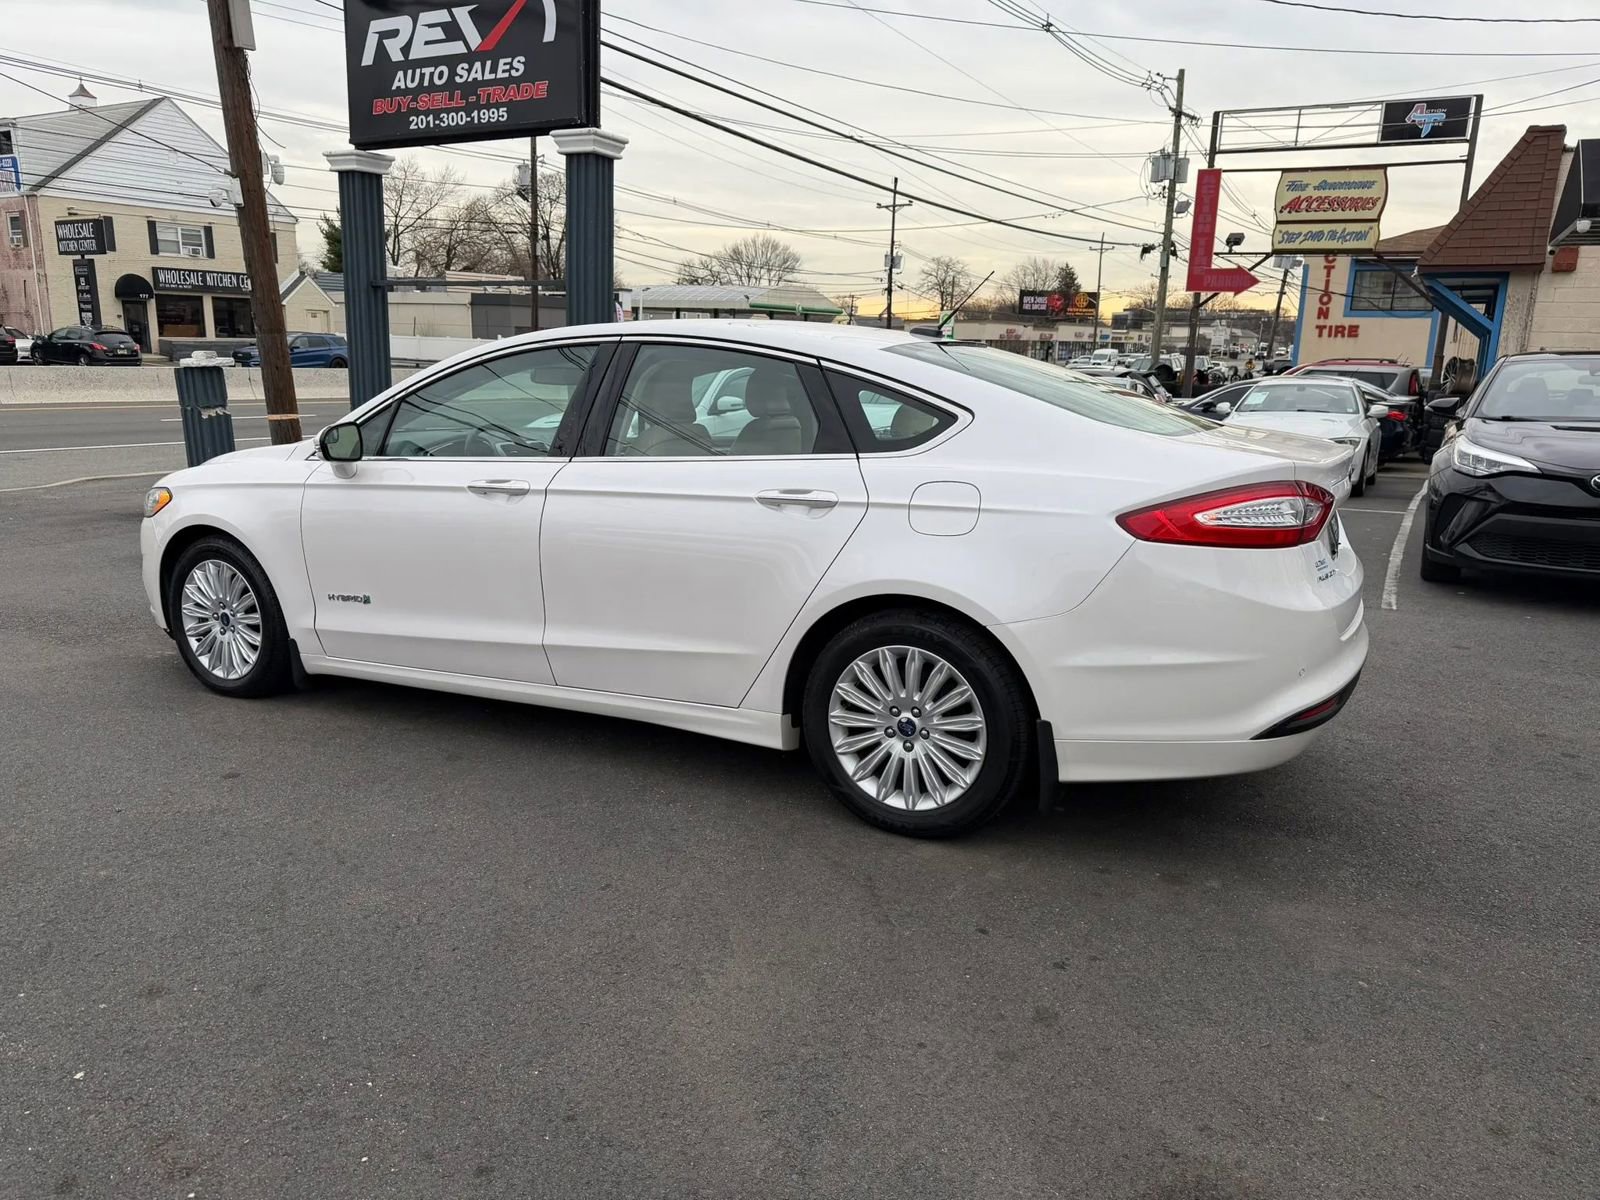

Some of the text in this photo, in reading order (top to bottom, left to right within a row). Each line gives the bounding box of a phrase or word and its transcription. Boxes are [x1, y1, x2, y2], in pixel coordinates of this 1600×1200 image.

[392, 56, 526, 90] AUTO SALES
[409, 107, 508, 130] 201-300-1995
[1197, 175, 1217, 233] ACTION
[1279, 195, 1381, 214] ACCESSORIES
[56, 222, 95, 239] WHOLESALE
[59, 239, 97, 252] KITCHEN CENTER
[158, 269, 204, 286] WHOLESALE
[206, 272, 237, 287] KITCHEN
[1203, 274, 1251, 287] PARKING
[1317, 254, 1337, 320] CTION
[1023, 296, 1034, 304] OPEN
[1315, 324, 1360, 338] TIRE
[328, 594, 363, 603] HYBRID
